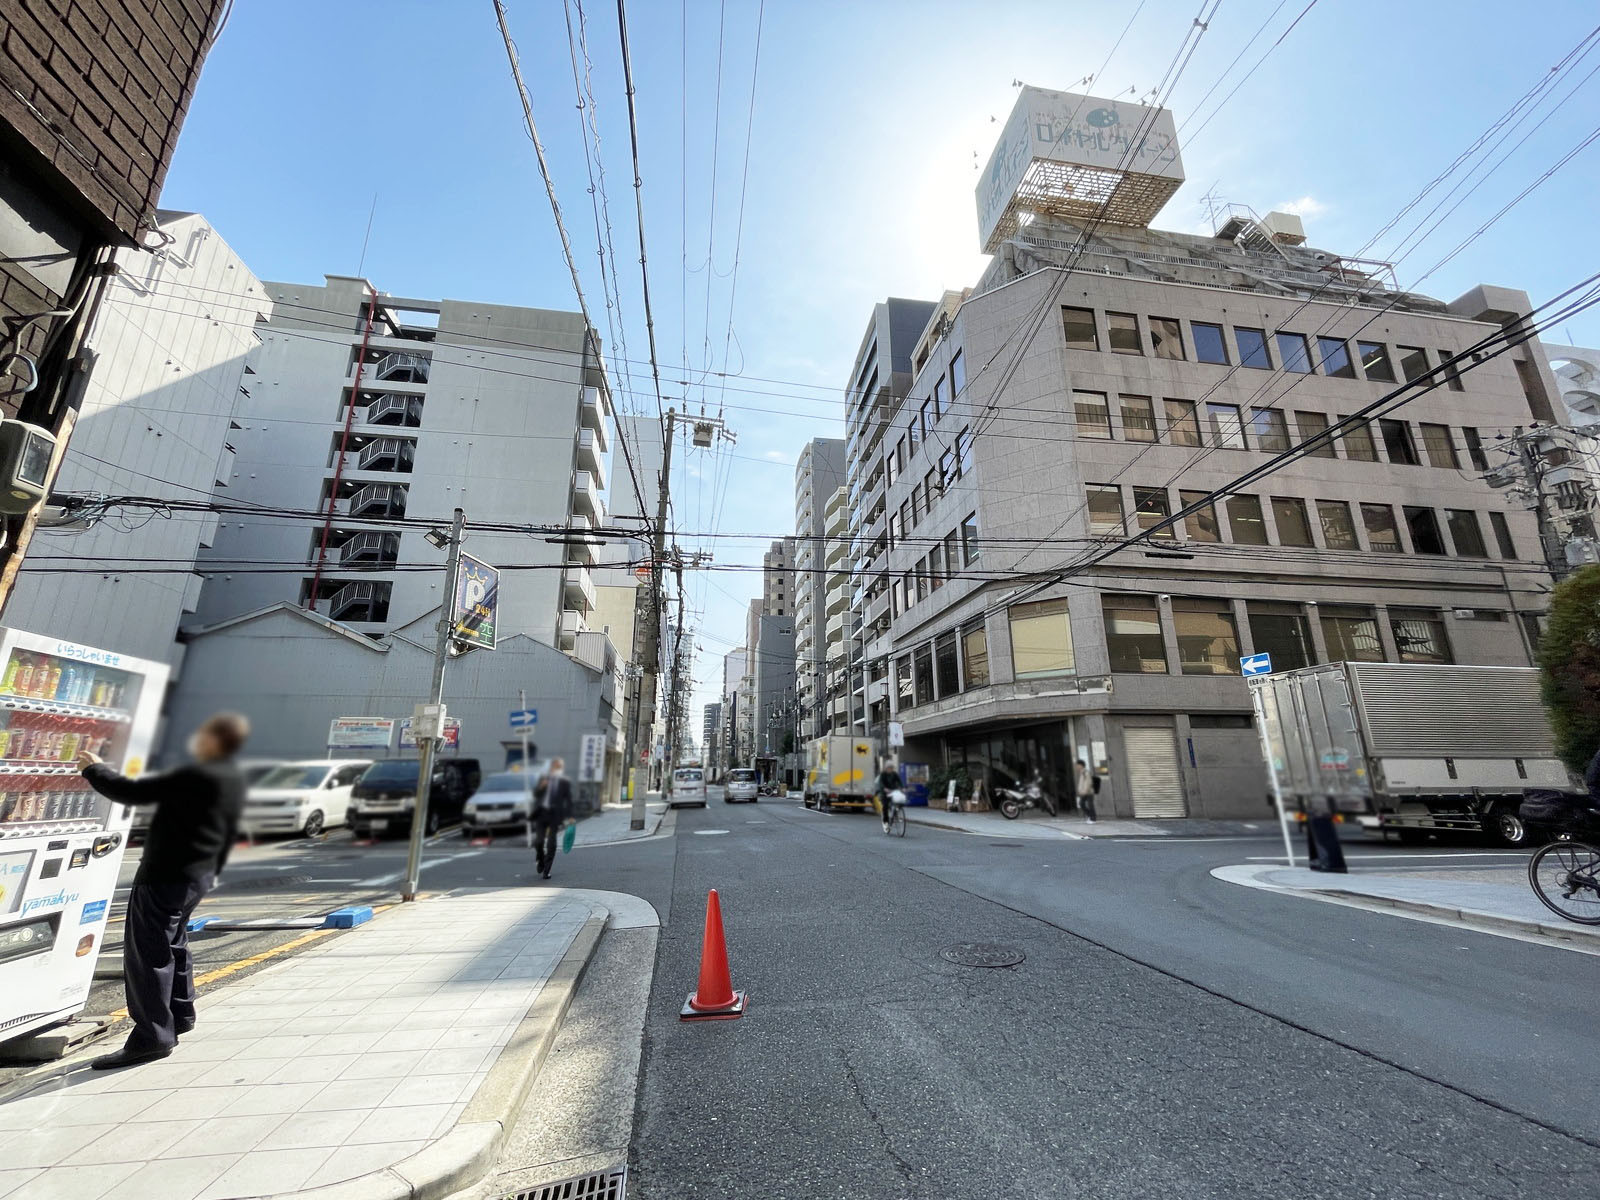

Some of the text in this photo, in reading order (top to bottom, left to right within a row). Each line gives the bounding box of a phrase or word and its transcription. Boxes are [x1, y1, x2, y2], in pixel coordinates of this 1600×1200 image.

[465, 580, 486, 610] P
[480, 622, 493, 646] 空
[57, 643, 120, 666] いらっしゃいませ
[20, 888, 80, 918] yamakyu
